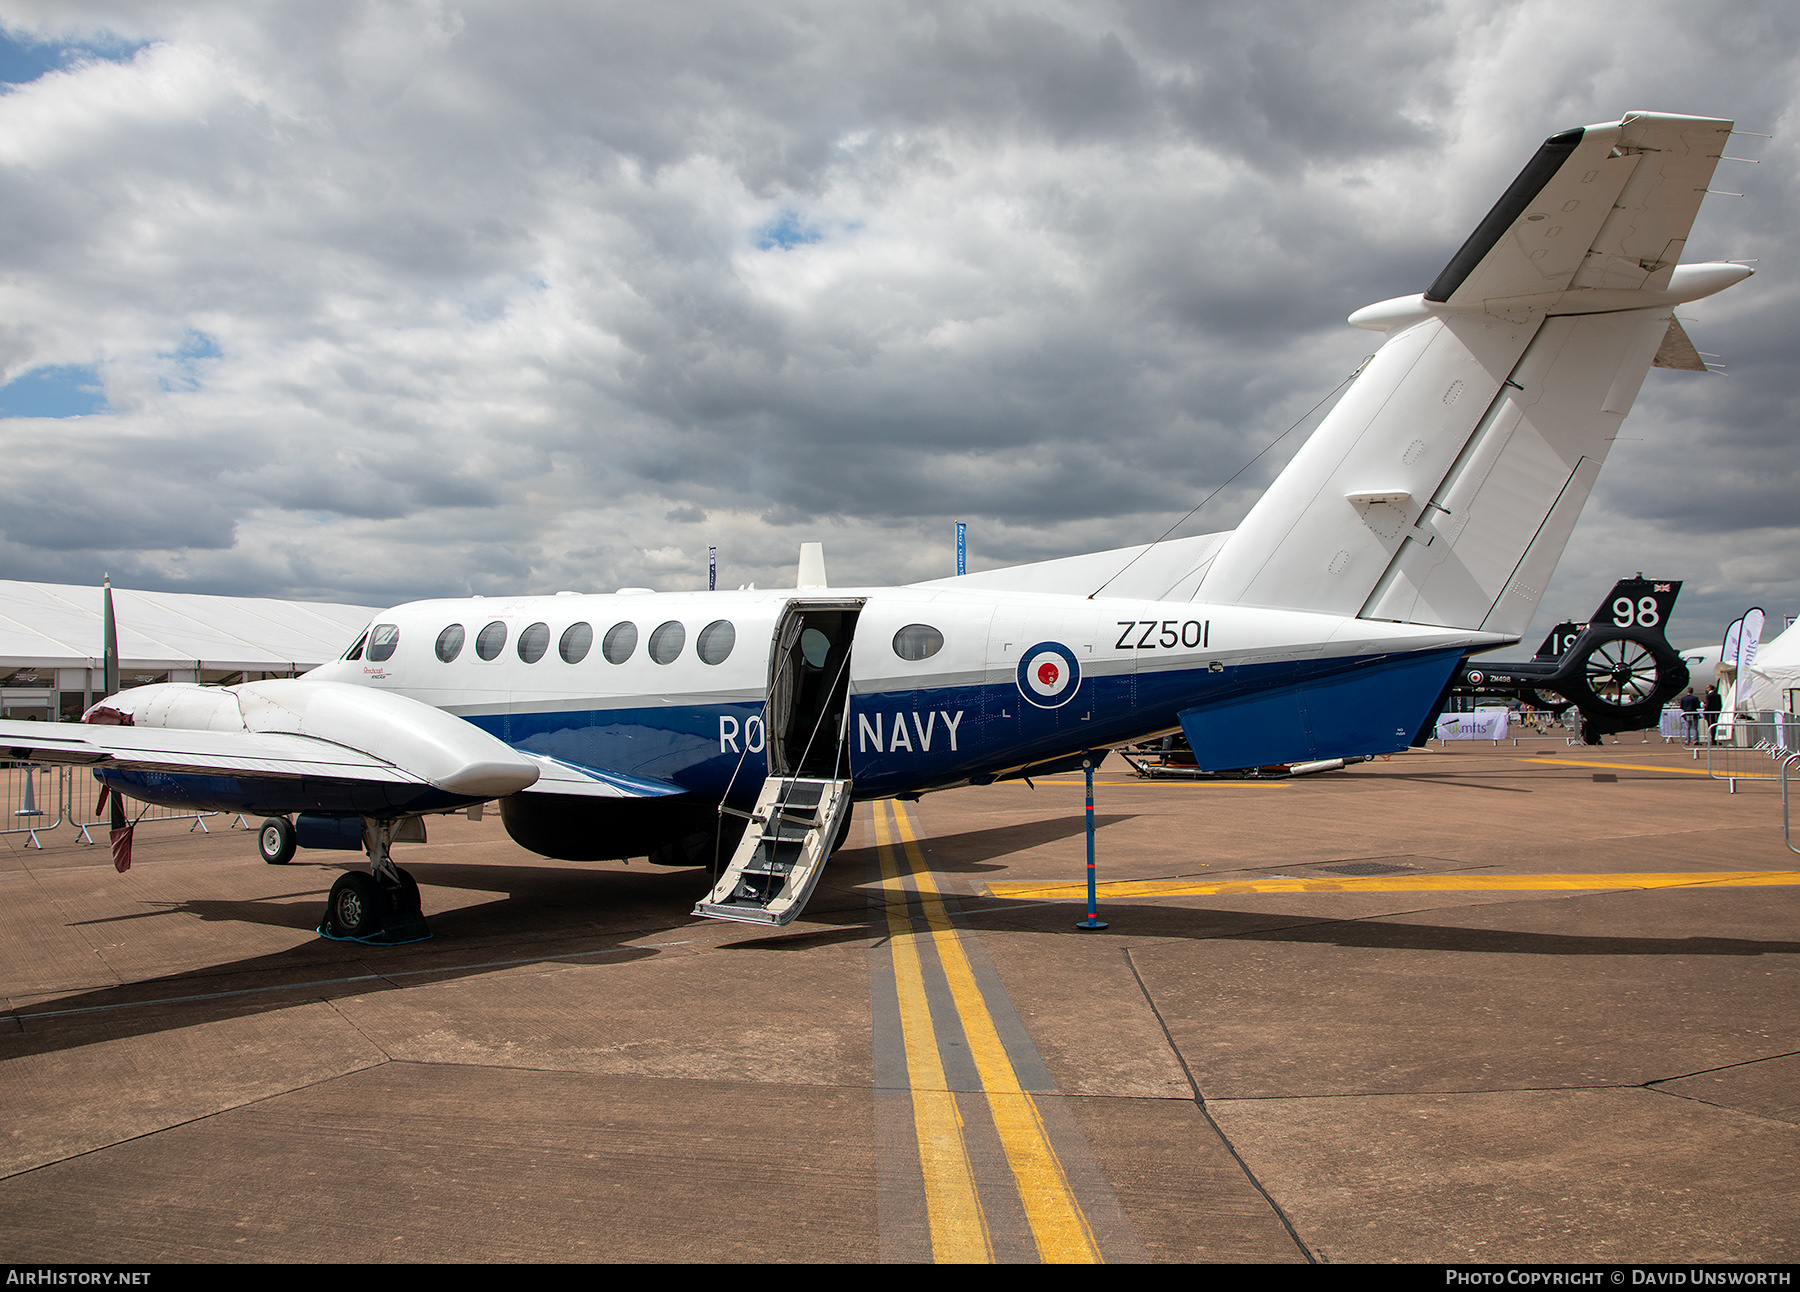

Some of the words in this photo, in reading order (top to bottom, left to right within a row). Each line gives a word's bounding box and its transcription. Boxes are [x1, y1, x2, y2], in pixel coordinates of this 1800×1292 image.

[1612, 596, 1660, 628] 98
[1115, 620, 1210, 650] ZZ501
[1741, 639, 1758, 680] ukmfts
[1489, 674, 1512, 684] ZM498
[858, 710, 965, 753] NAVY
[1448, 722, 1487, 734] ukmfts
